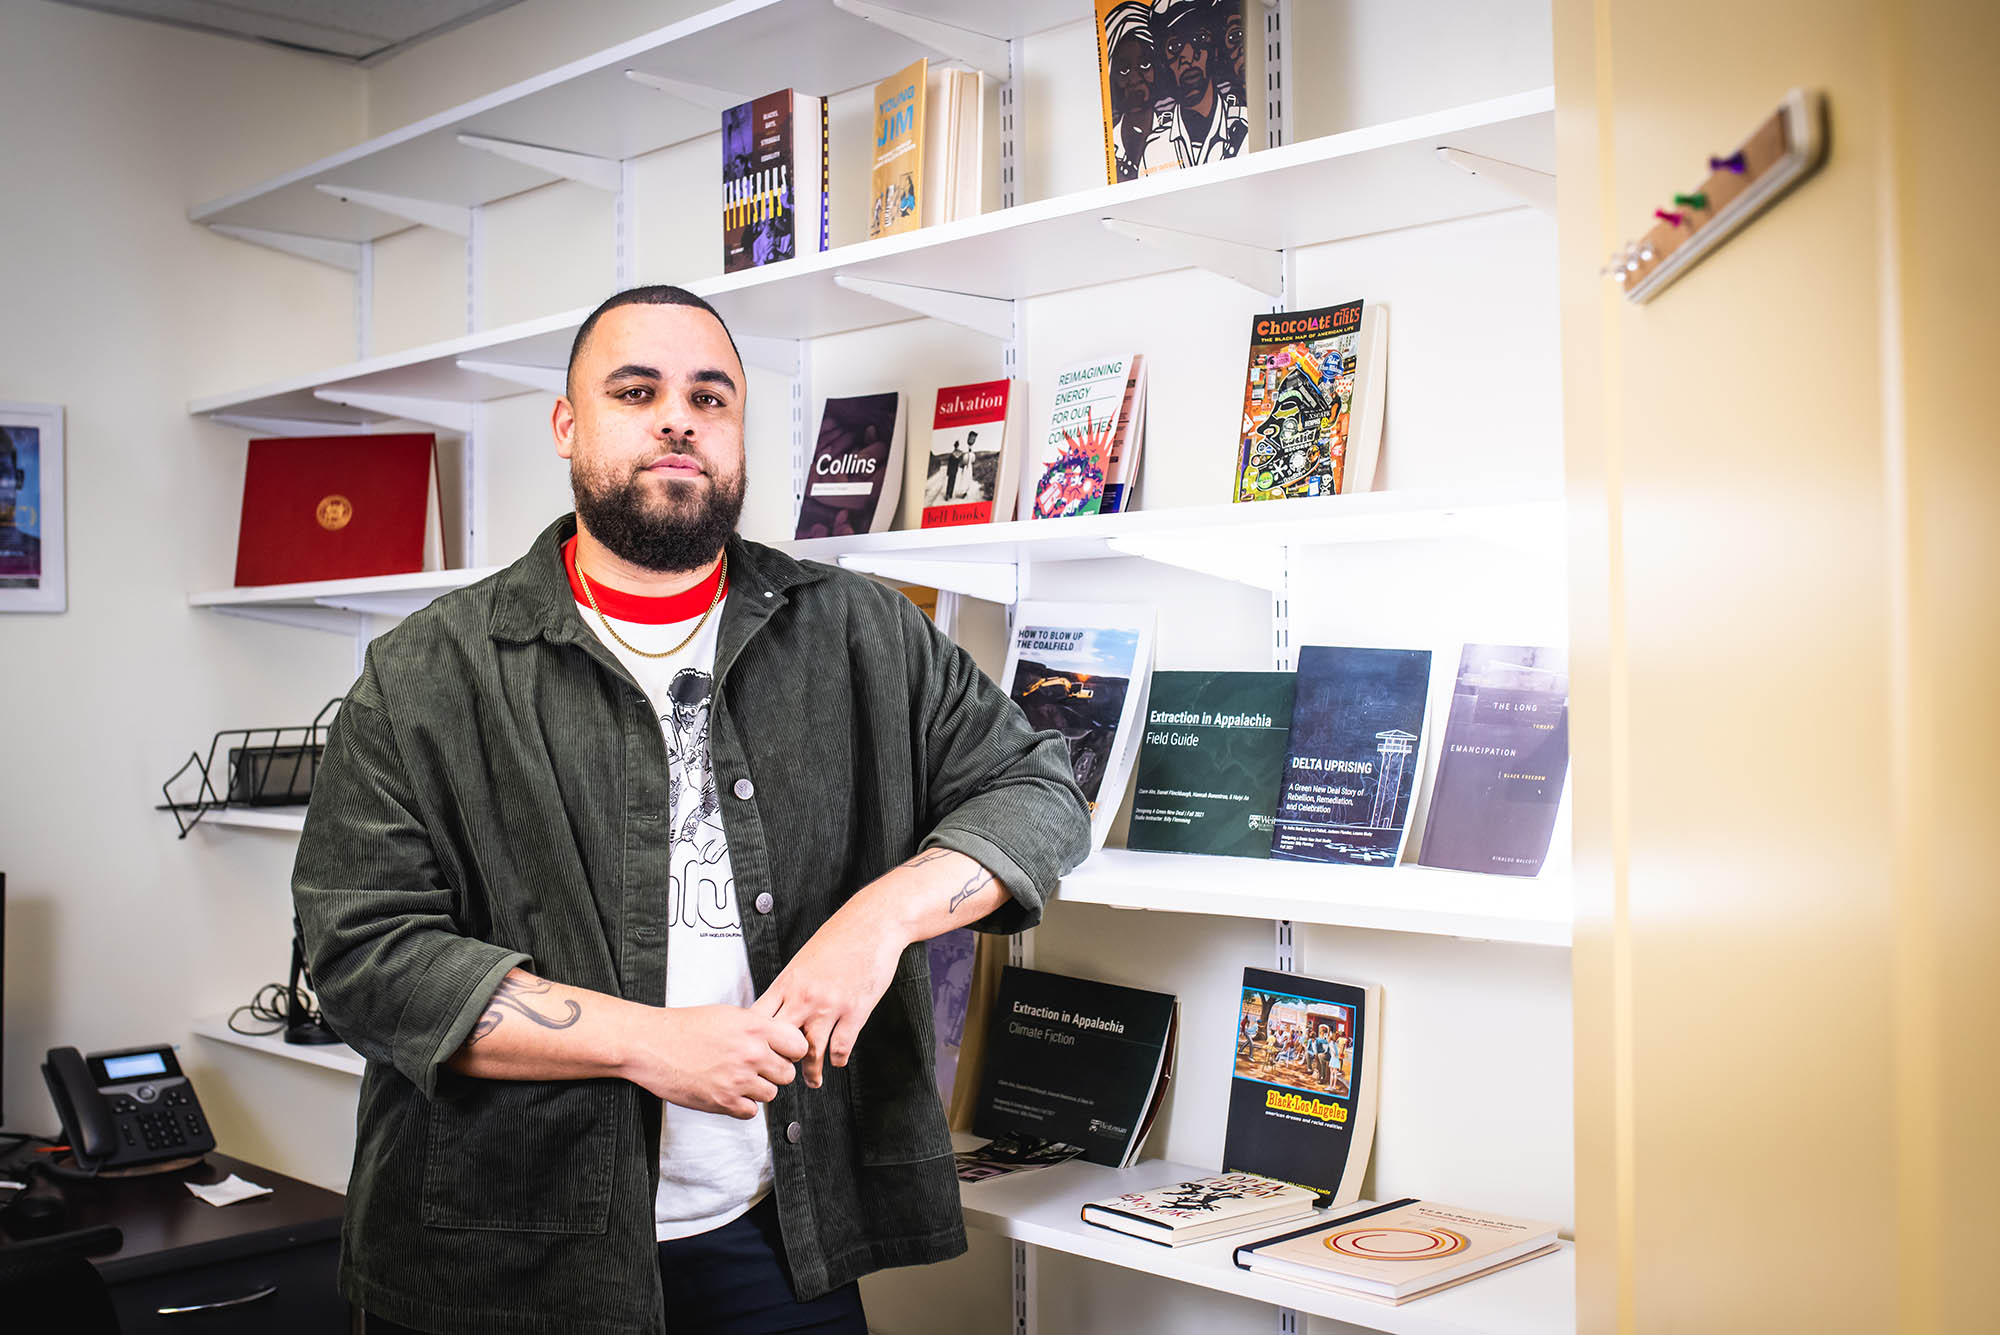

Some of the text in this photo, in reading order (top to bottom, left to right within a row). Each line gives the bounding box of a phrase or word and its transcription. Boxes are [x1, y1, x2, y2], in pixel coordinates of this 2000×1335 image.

[880, 84, 915, 116] YOUNG
[877, 104, 914, 147] JIM
[1317, 329, 1343, 337] AMERICAN
[1058, 362, 1122, 386] REIMAGINING
[940, 392, 1003, 415] salvation
[1055, 387, 1092, 406] ENERGY
[1052, 406, 1091, 425] FOR OUR
[1048, 419, 1113, 444] COMMUNITIES
[816, 453, 876, 475] Collins
[1018, 630, 1083, 641] HOW TO BLOW UP
[1017, 640, 1074, 650] THE COALFIELD
[1494, 703, 1538, 712] THE LONG
[1150, 711, 1272, 728] Extraction in Appalachia
[1146, 732, 1199, 746] Field Guide
[1450, 745, 1517, 756] EMANCIPATION
[1292, 757, 1372, 774] DELTA UPRISING
[1294, 784, 1312, 792] Green
[1327, 786, 1341, 794] Deal
[1341, 788, 1357, 797] Story
[1357, 788, 1364, 796] of
[1287, 793, 1354, 806] Rebellion, Remediation,
[1298, 804, 1331, 813] Celebration
[1013, 1001, 1125, 1033] Extraction in Appalachia
[1009, 1022, 1075, 1046] Climate Fiction
[1268, 1092, 1345, 1120] Black Los Angeles
[1286, 1114, 1302, 1122] dreams
[1226, 1176, 1290, 1191] OPEN
